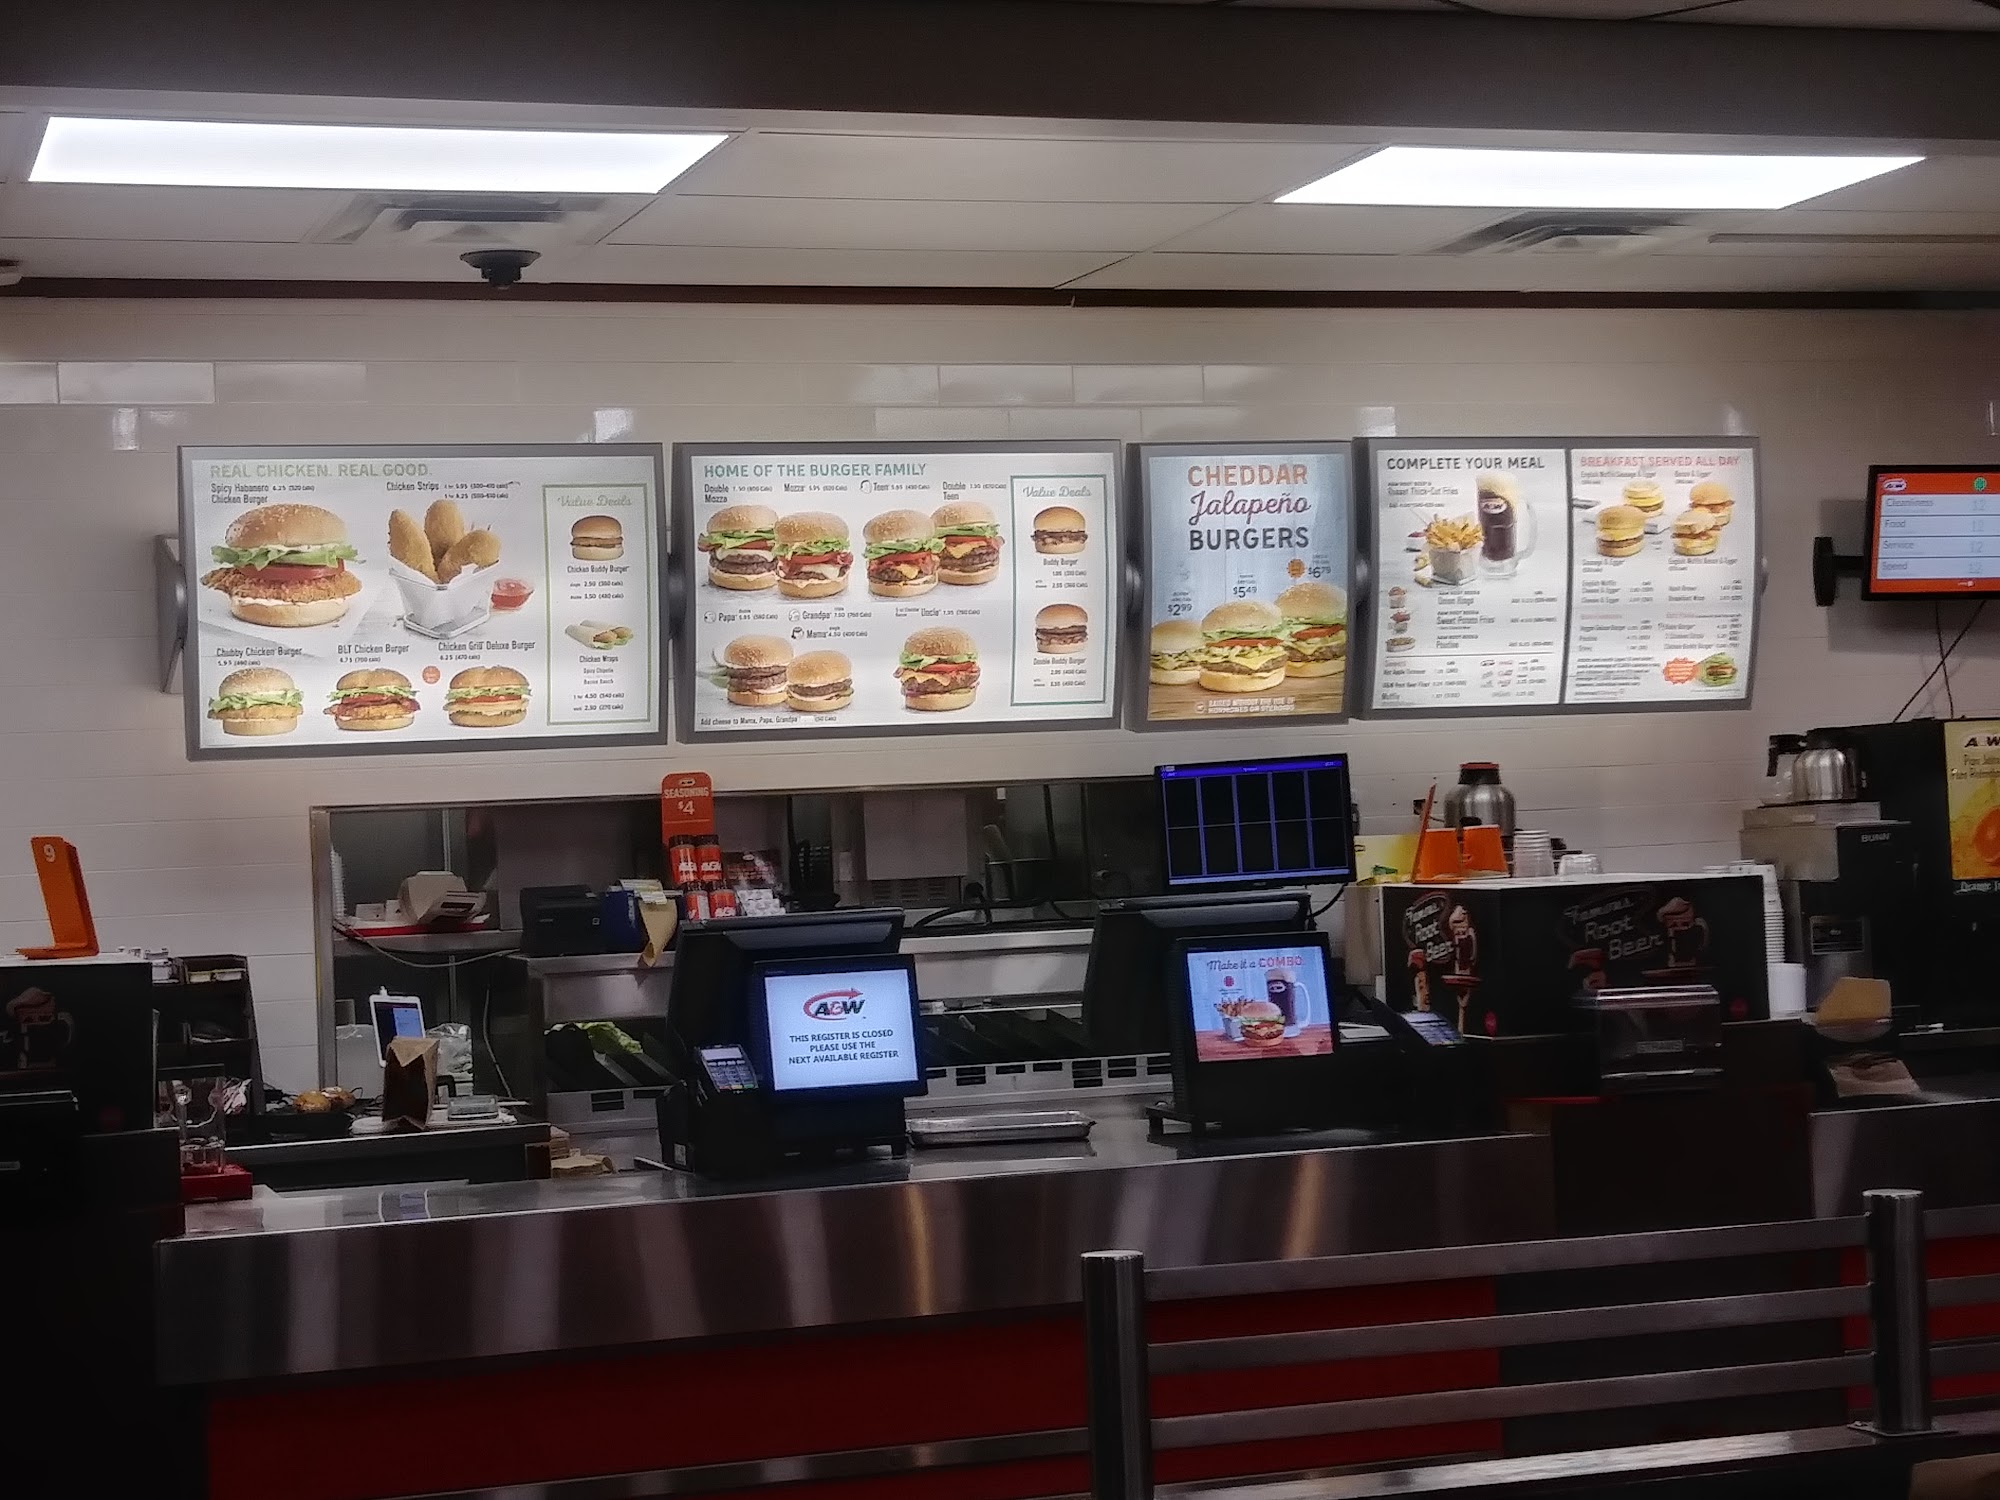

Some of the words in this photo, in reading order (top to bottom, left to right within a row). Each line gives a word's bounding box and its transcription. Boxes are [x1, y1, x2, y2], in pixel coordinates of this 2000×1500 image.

[1387, 458, 1461, 470] COMPLETE
[1466, 457, 1503, 469] YOUR
[1508, 457, 1545, 469] MEAL
[1581, 456, 1645, 467] BREAKFAST
[1649, 456, 1692, 467] SERVED
[1696, 456, 1715, 466] ALL
[1719, 456, 1739, 466] DAY
[209, 464, 250, 478] REAL
[256, 464, 332, 477] CHICKEN.
[338, 463, 378, 477] REAL
[382, 463, 432, 476] GOOD.
[704, 465, 748, 477] HOME
[753, 465, 773, 477] OF
[777, 464, 805, 477] THE
[810, 464, 871, 477] BURGER
[875, 463, 926, 476] FAMILY
[1188, 463, 1308, 486] CHEDDAR
[211, 483, 232, 495] Spicy
[386, 482, 415, 491] Chicken
[417, 481, 439, 492] Strips
[704, 484, 729, 493] Double
[943, 482, 966, 491] Double
[1023, 486, 1056, 498] Value
[1059, 486, 1091, 498] Deals
[211, 494, 241, 504] Chicken
[243, 494, 268, 505] Burger
[558, 495, 594, 507] Value
[596, 494, 632, 507] Deals
[705, 494, 728, 503] Mozza
[943, 492, 959, 501] Teen
[1188, 490, 1311, 525] Jalapeño
[1885, 519, 1906, 528] Food
[1190, 527, 1309, 550] BURGERS
[338, 645, 351, 654] BLT
[354, 644, 383, 654] Chicken
[385, 644, 409, 655] Burger
[438, 641, 466, 651] Chicken
[486, 641, 509, 650] Deluxe
[511, 640, 535, 651] Burger
[217, 648, 243, 659] Chubby
[245, 647, 275, 657] Chicken
[278, 646, 302, 657] Burger
[579, 655, 601, 663] Chicken
[664, 787, 709, 799] SEASONING
[678, 800, 695, 816] $4
[1861, 833, 1891, 843] BUNN
[43, 844, 56, 862] 9
[1585, 914, 1634, 943] Root
[1609, 934, 1664, 961] Beer
[1207, 959, 1239, 972] Make
[1240, 958, 1248, 970] it
[1249, 961, 1257, 969] a
[1259, 955, 1302, 968] COMBO
[815, 1000, 866, 1017] A&W
[790, 1035, 809, 1043] THIS
[811, 1031, 851, 1042] REGISTER
[852, 1031, 860, 1039] IS
[862, 1029, 893, 1039] CLOSED
[810, 1043, 840, 1053] PLEASE
[842, 1042, 857, 1050] USE
[859, 1041, 876, 1049] THE
[789, 1055, 811, 1065] NEXT
[813, 1051, 858, 1063] AVAILABLE
[860, 1050, 899, 1060] REGISTER
